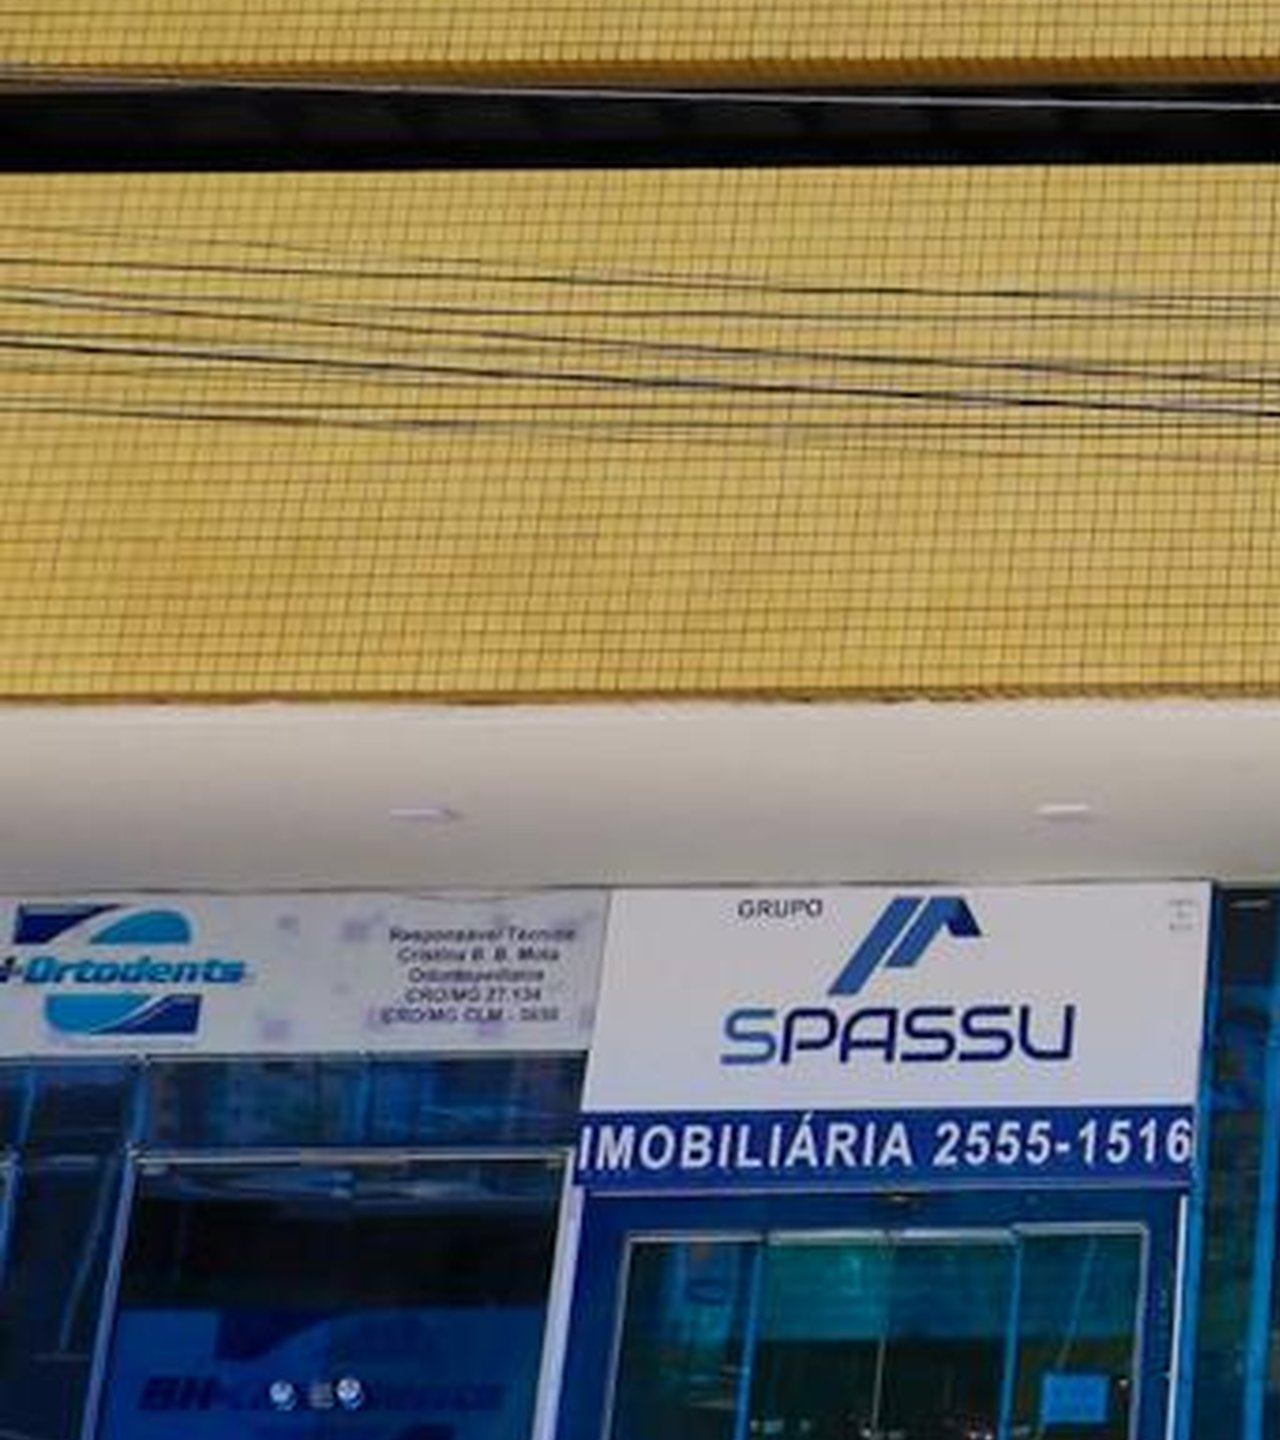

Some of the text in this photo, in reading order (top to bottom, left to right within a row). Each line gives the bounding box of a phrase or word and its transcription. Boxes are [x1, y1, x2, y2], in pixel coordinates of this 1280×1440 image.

[737, 898, 824, 921] GRUPO
[719, 1004, 1077, 1064] SPASSU
[578, 1113, 1193, 1171] IMOBILIÁRIA 2555-1516
